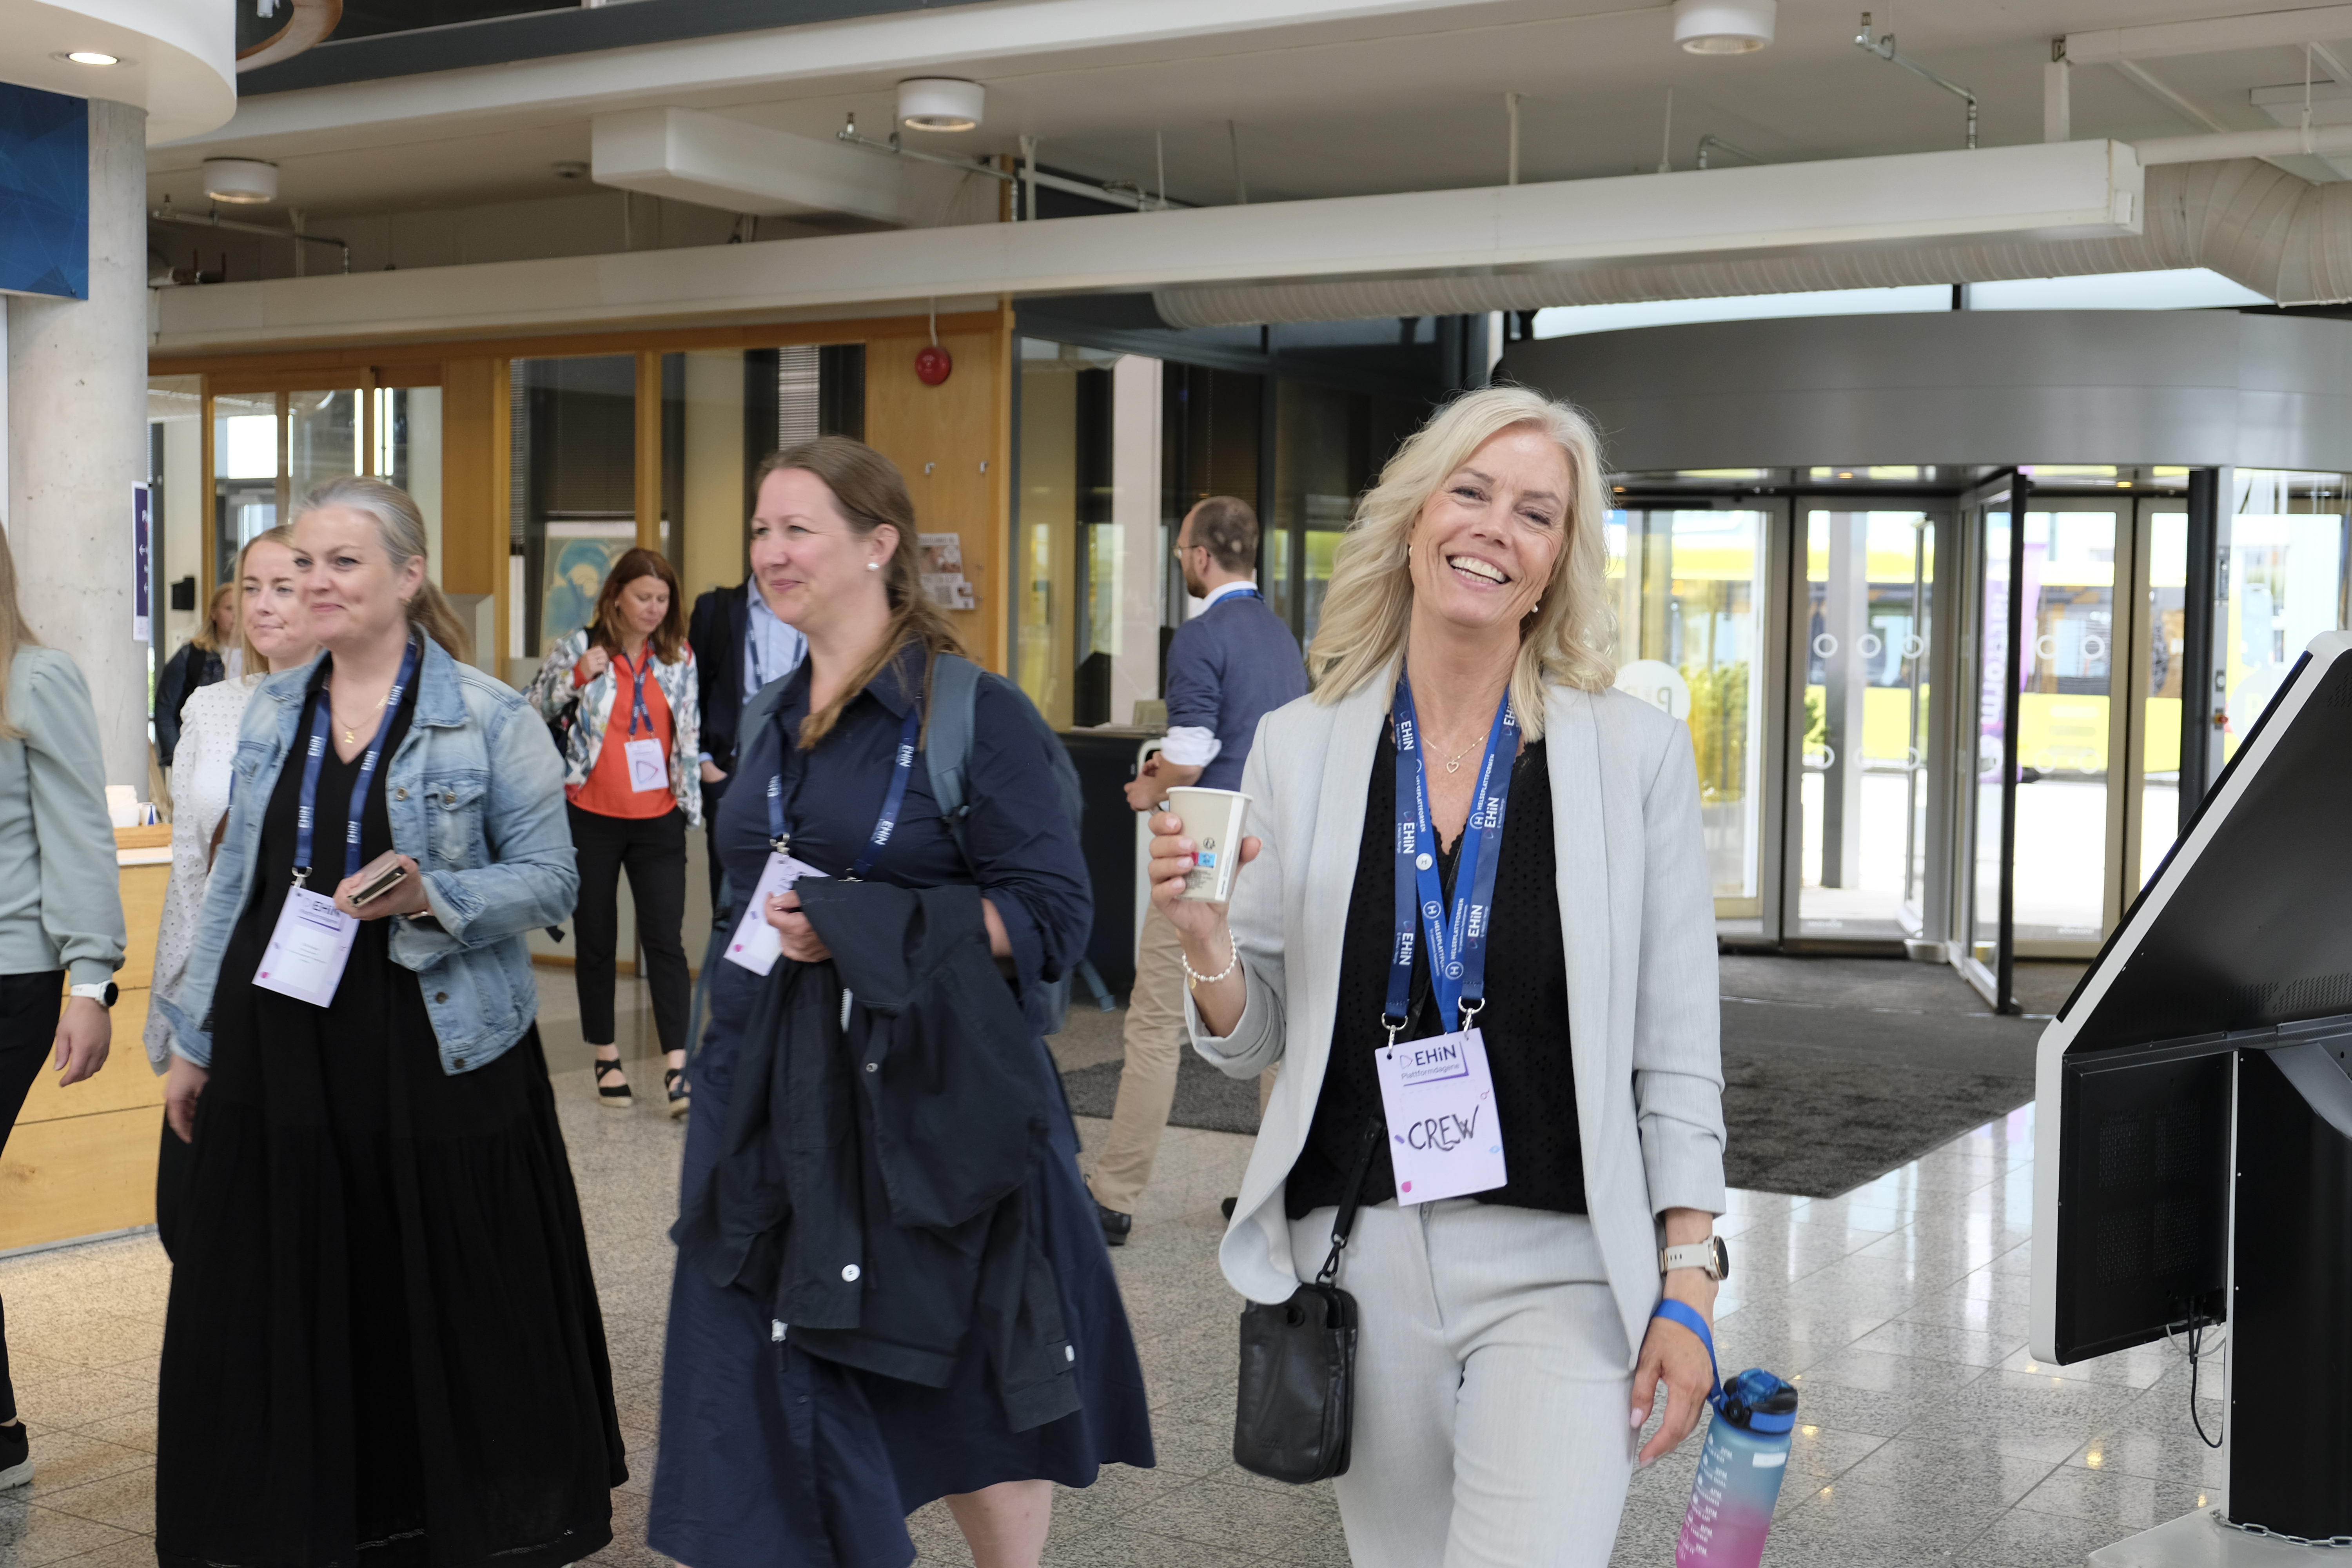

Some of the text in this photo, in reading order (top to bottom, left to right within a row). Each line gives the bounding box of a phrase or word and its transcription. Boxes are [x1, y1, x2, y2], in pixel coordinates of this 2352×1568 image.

[1401, 720, 1414, 750] EHiN
[1477, 753, 1495, 810] HELSEPLATTFORMEN
[1485, 798, 1499, 828] EHiN
[1403, 822, 1414, 854] EHiN
[1468, 905, 1483, 937] EHiN
[1399, 933, 1414, 965] EHiN
[1415, 1044, 1456, 1065] EHiN
[1401, 1063, 1460, 1079] Plattformdagene
[1408, 1105, 1479, 1151] CREW
